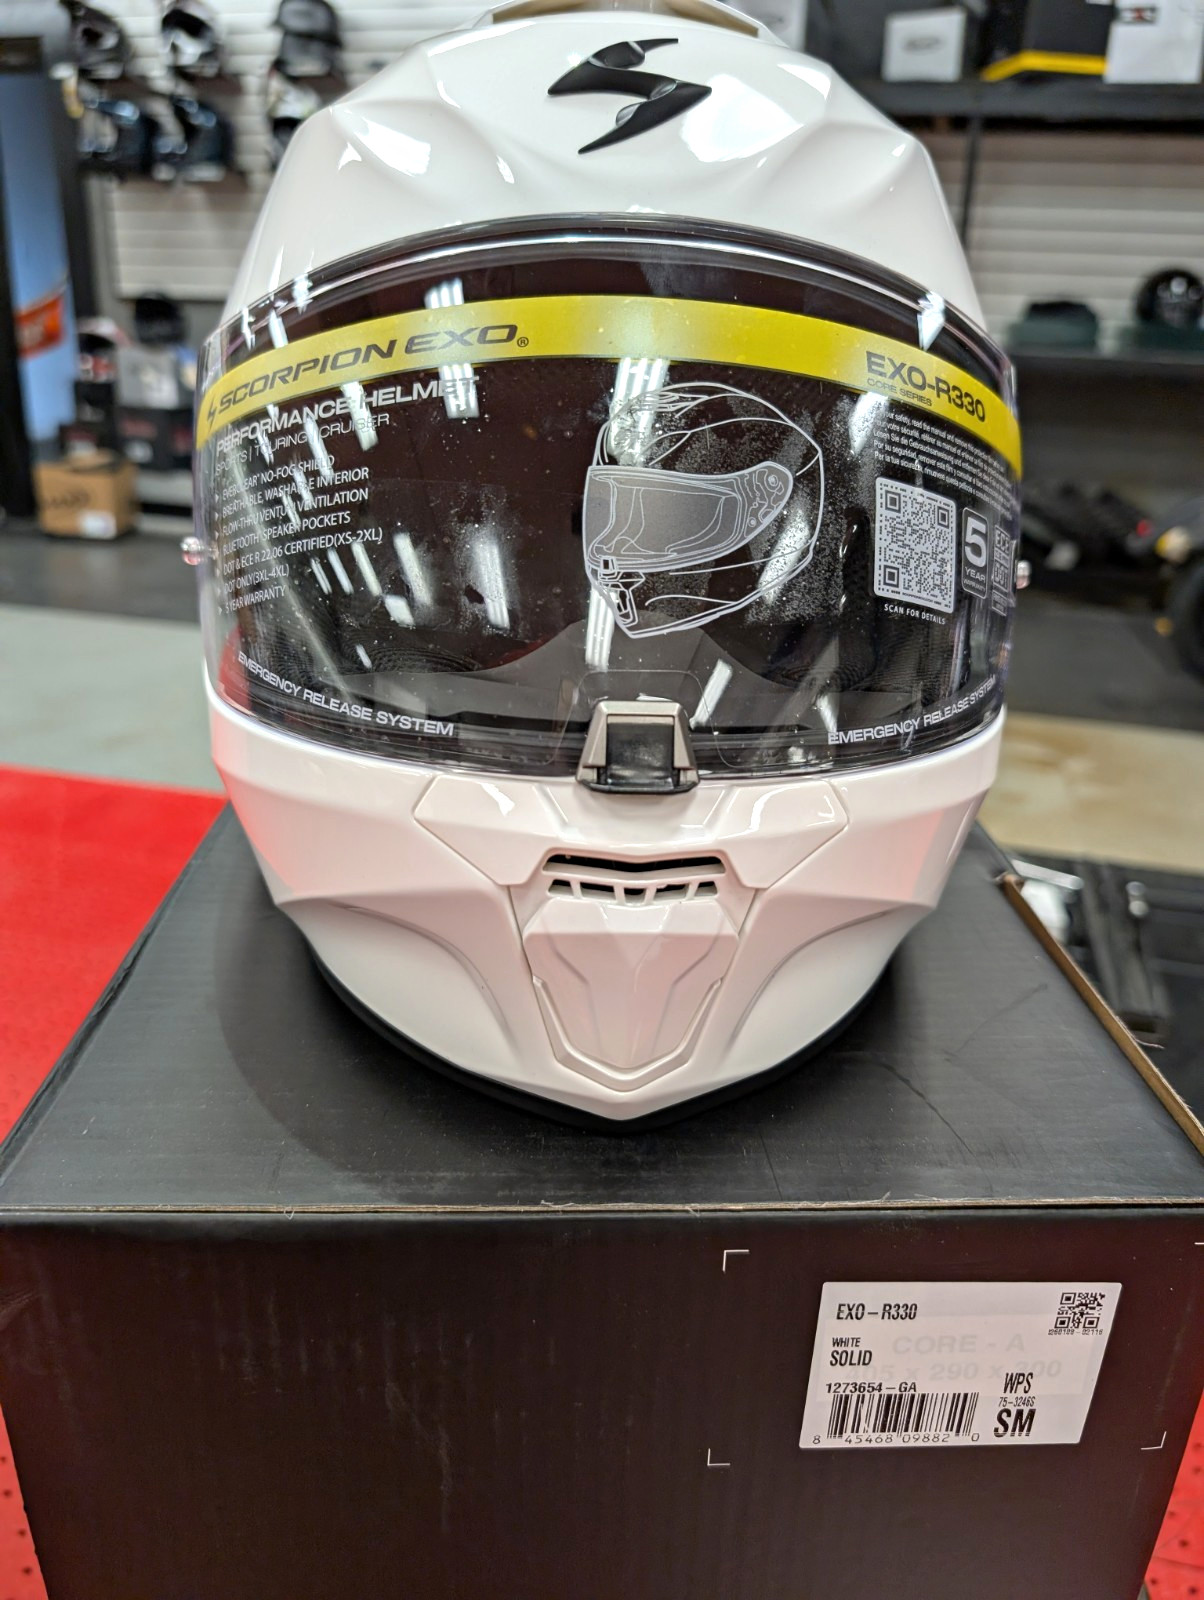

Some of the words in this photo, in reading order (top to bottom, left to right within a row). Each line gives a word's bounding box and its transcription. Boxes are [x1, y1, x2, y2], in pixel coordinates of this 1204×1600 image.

[219, 339, 397, 413] SCORPION
[866, 350, 986, 423] EXO-R330
[867, 377, 897, 394] CORE
[900, 389, 932, 407] SERIES
[216, 396, 352, 457] PERFORMANCE
[361, 375, 480, 409] HELMET
[254, 431, 308, 457] TURING
[319, 412, 390, 439] CRUISER
[260, 463, 297, 485] NO-FOG
[298, 454, 335, 473] SHIED
[264, 477, 315, 502] WASHAE
[317, 466, 370, 488] INTERIOR
[259, 501, 297, 522] VENTUI
[297, 487, 369, 512] VENTILATION
[262, 522, 301, 541] SPEAKER
[302, 511, 351, 532] POCKETS
[223, 560, 236, 576] DOT
[235, 558, 241, 570] &
[241, 553, 254, 568] ECE
[254, 551, 260, 564] R
[260, 545, 283, 562] 22.06
[284, 527, 384, 556] CERTIFIED(XS-2XL)
[964, 516, 987, 568] 5
[223, 580, 236, 595] DOT
[235, 563, 291, 589] ONLY(3XL-4XL)
[964, 566, 987, 583] YEAR
[228, 597, 245, 612] YEAR
[243, 584, 287, 607] WARRANTY
[884, 603, 904, 615] SCAN
[906, 607, 920, 618] FOR
[921, 611, 946, 625] DETAILS
[238, 651, 302, 698] EMERGENCY
[302, 687, 372, 721] RELEASE
[375, 710, 454, 737] SYSTEM
[827, 716, 921, 746] EMERGENCY
[923, 696, 970, 727] RELEASE
[969, 674, 996, 705] SYSTEM
[831, 1337, 862, 1348] WHITE
[892, 1334, 978, 1355] CORE
[1004, 1332, 1026, 1353] A
[829, 1350, 873, 1367] SOLID
[929, 1361, 980, 1382] 290
[1003, 1371, 1034, 1394] WPS
[993, 1407, 1037, 1438] SM
[812, 1434, 821, 1445] 8
[844, 1433, 894, 1445] 45468
[901, 1432, 951, 1444] 09882
[971, 1432, 980, 1443] 0
